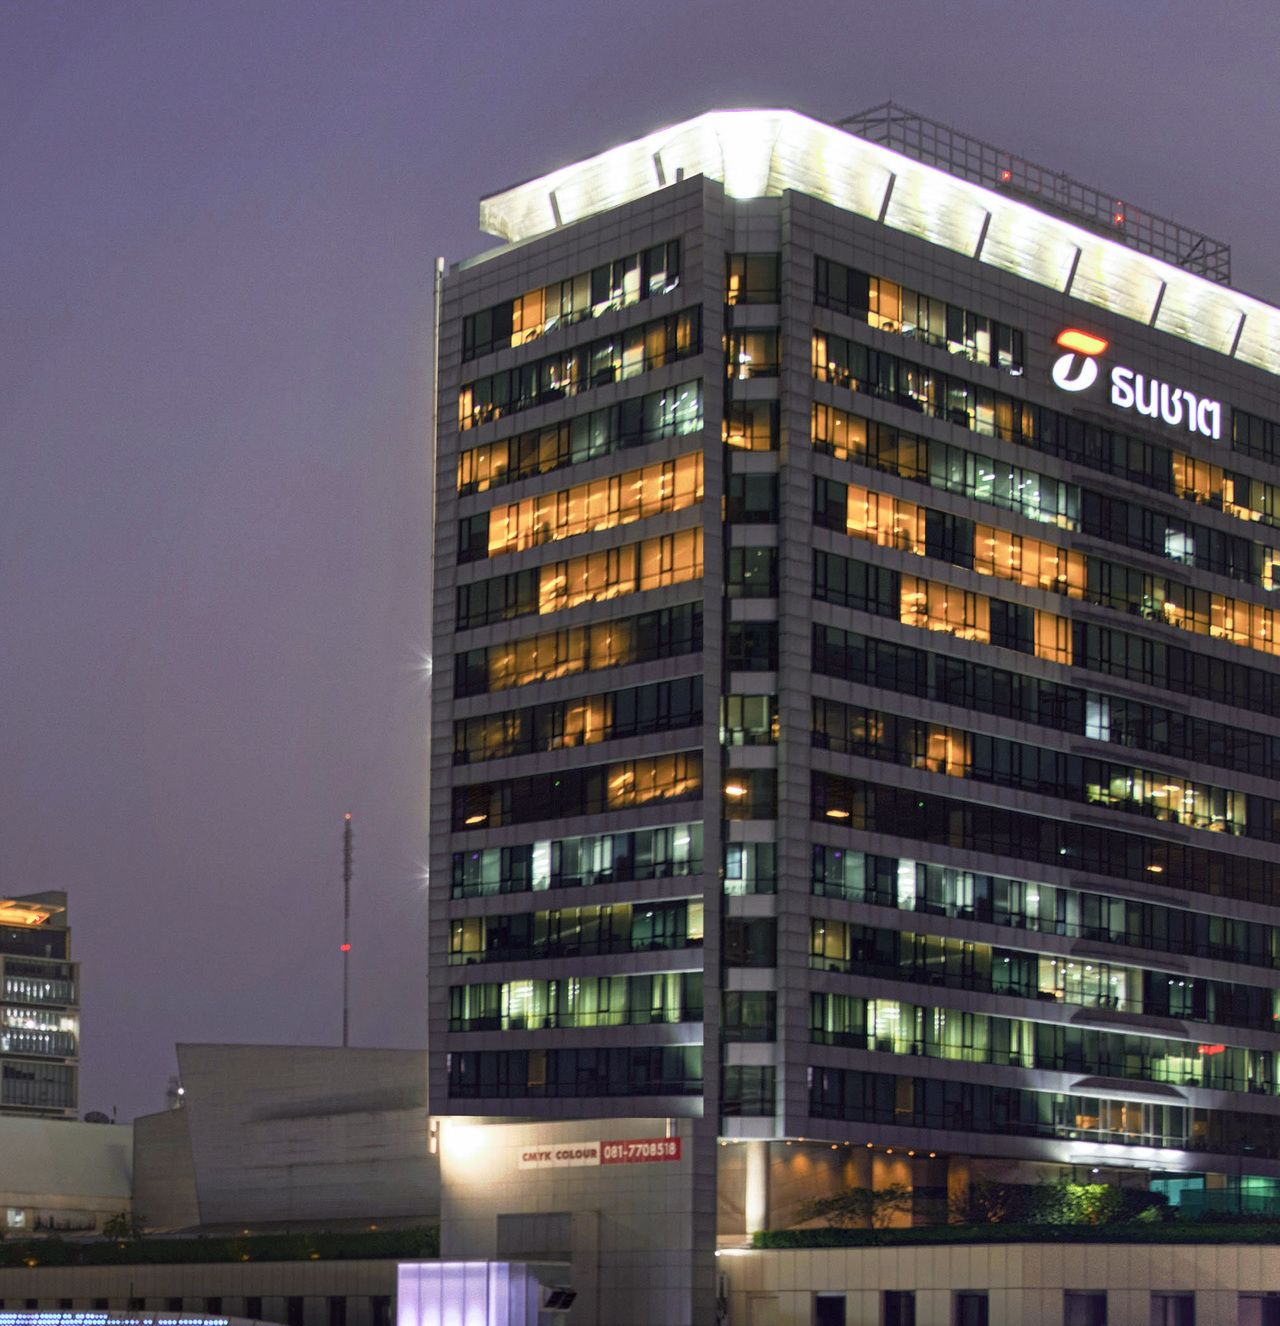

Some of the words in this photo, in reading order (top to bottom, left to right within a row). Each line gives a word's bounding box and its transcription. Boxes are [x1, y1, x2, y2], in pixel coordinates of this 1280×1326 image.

[1111, 366, 1221, 440] ธนชาต
[522, 1153, 551, 1162] CMYK
[556, 1149, 597, 1160] COLOUR
